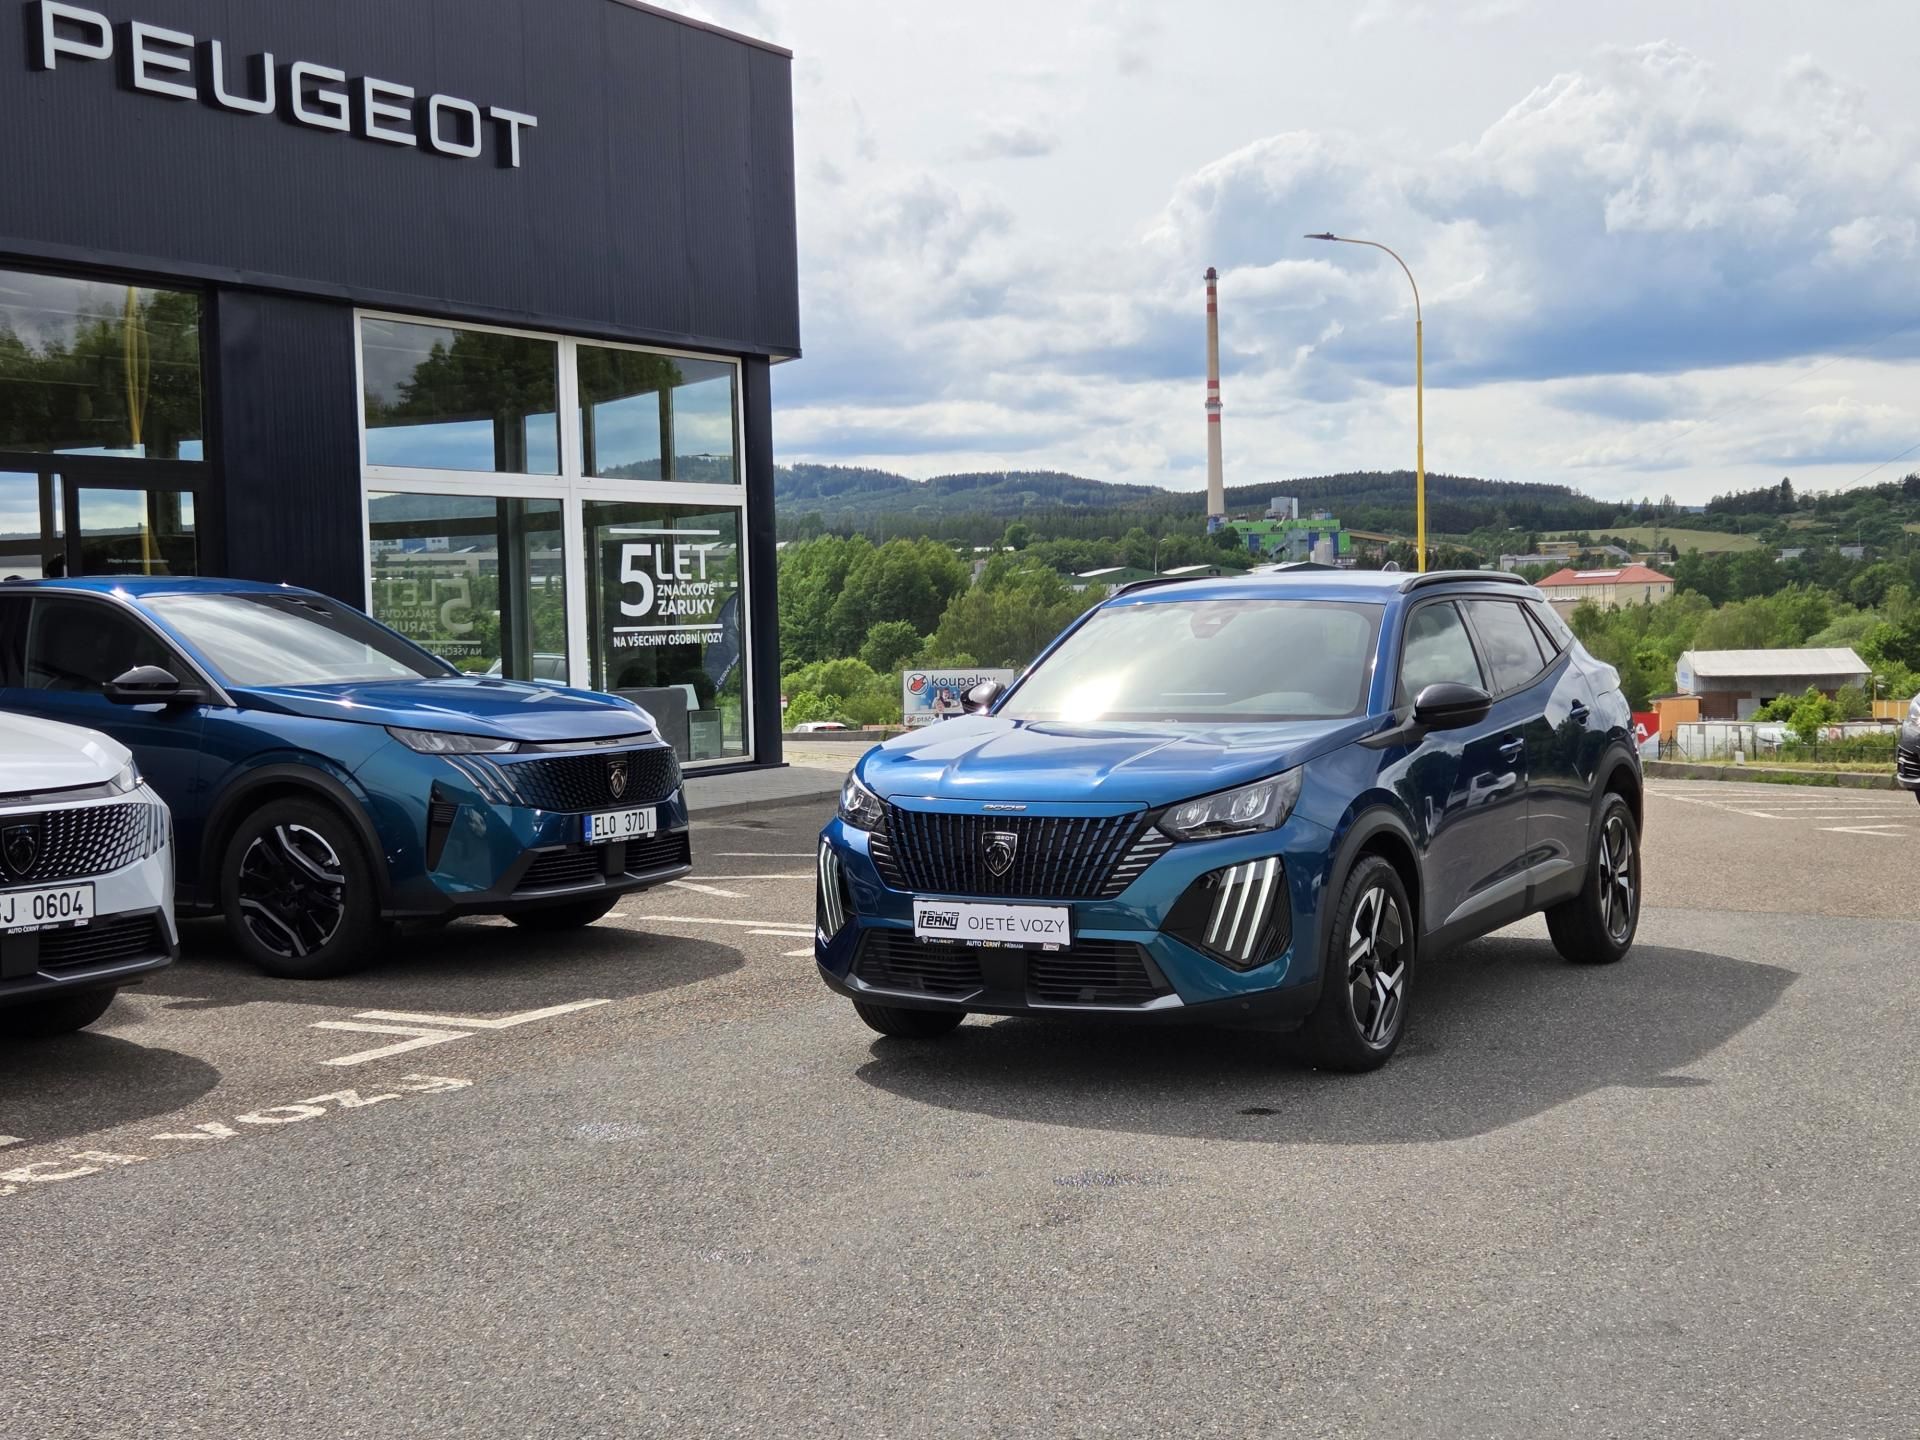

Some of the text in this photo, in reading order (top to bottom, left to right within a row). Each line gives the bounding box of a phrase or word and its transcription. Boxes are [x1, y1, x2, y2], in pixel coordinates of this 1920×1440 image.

[39, 0, 538, 168] PEUGEOT
[620, 543, 714, 617] 5 LET
[656, 581, 715, 596] ZNAČKOVÉ
[657, 596, 715, 616] ZÁRUKY
[613, 631, 723, 648] NA VŠECHNY OSOBNÍ VOZY
[0, 890, 83, 923] J 0604
[967, 916, 1065, 933] OJETÉ VOZY
